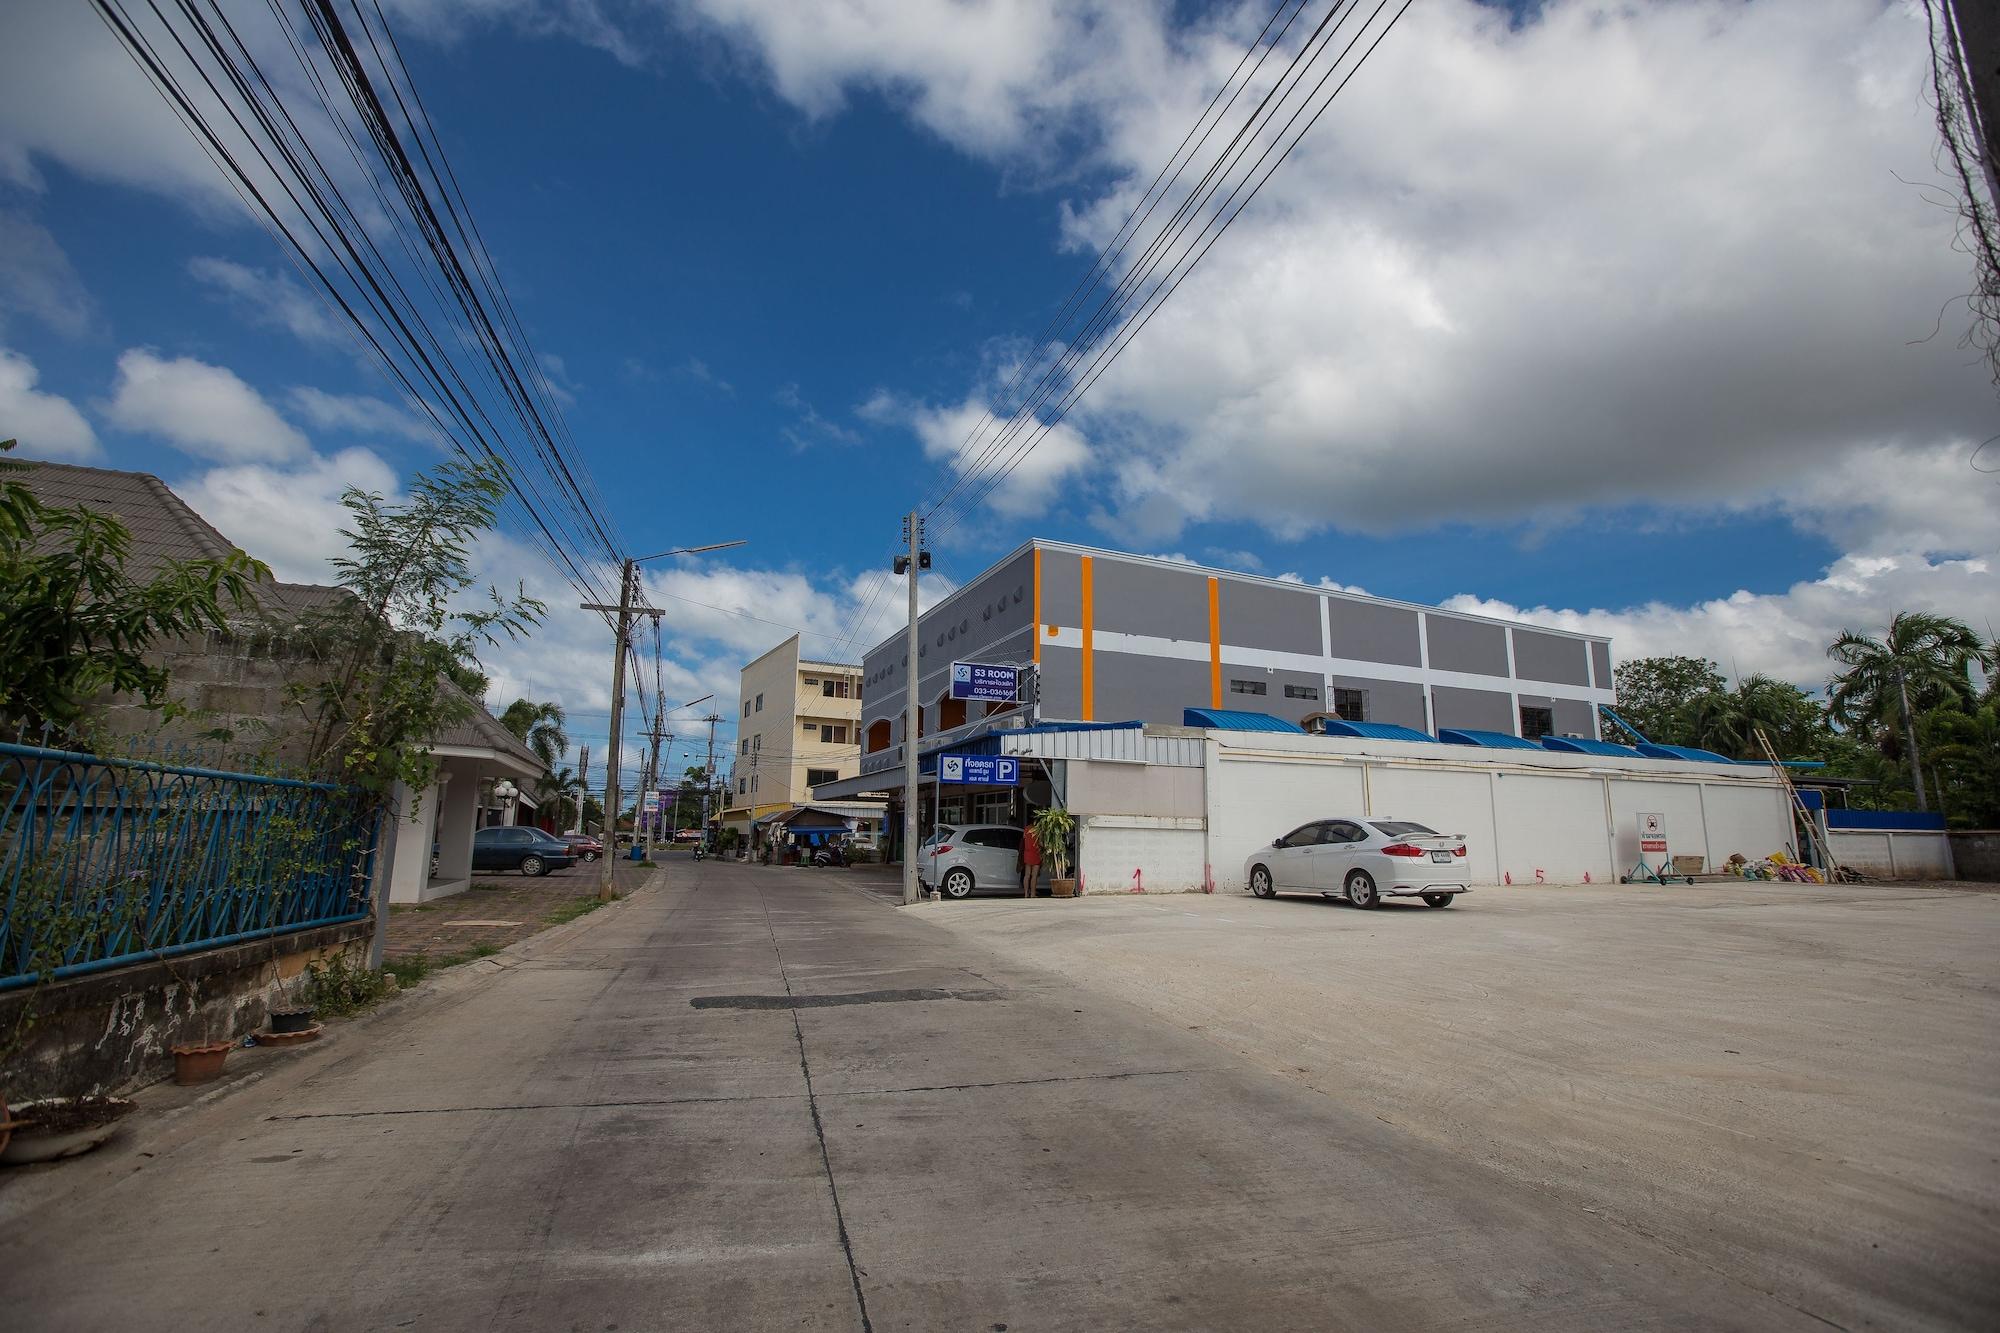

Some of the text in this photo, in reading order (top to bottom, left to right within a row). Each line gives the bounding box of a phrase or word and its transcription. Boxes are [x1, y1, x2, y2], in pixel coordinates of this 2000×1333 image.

[974, 669, 1014, 679] S3 ROOM
[964, 757, 994, 768] ที่จอดรถ
[999, 761, 1013, 779] P
[1536, 869, 1544, 884] 5
